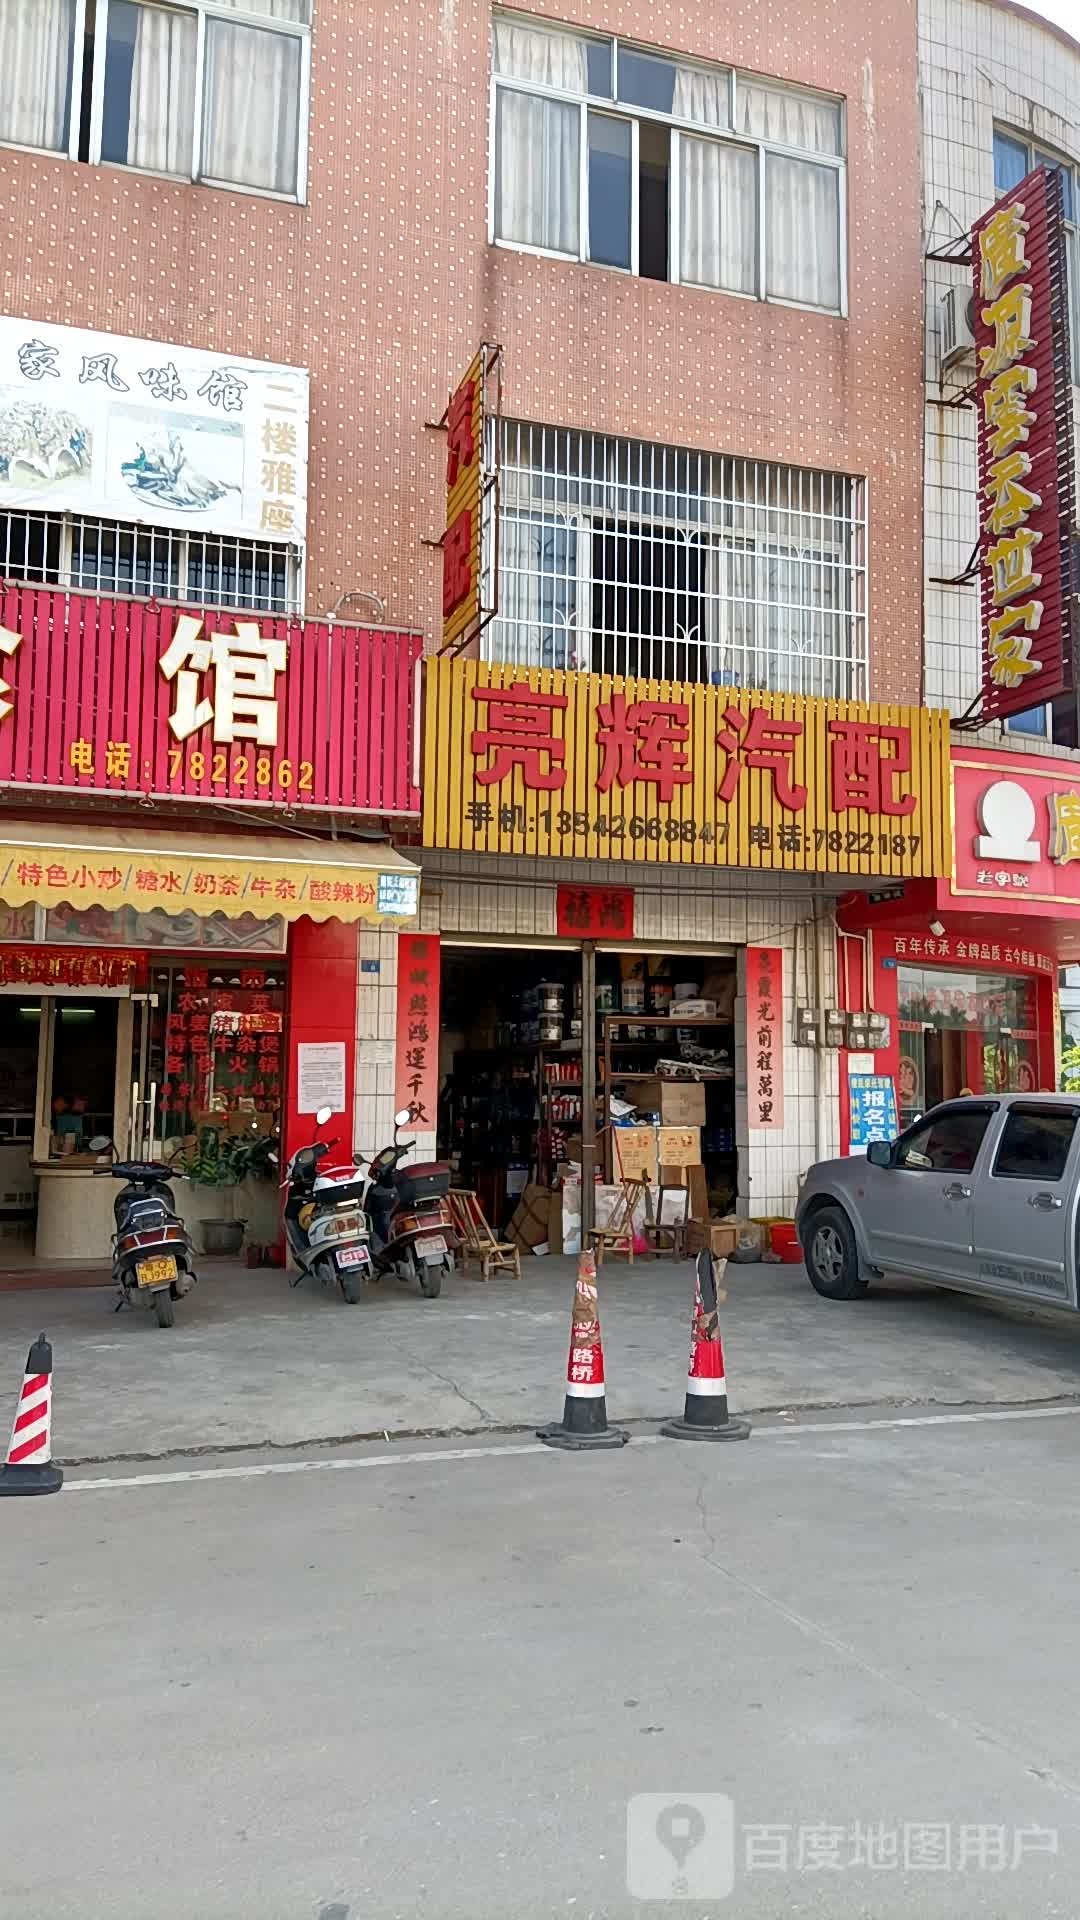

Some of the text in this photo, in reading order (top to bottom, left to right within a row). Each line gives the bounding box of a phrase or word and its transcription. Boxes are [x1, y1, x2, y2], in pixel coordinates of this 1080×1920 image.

[17, 339, 248, 412] 家风味馆
[260, 383, 298, 534] 二楼雅座
[159, 614, 287, 747] 馆
[471, 682, 917, 817] 亮辉汽配
[894, 937, 950, 956] 百年传承
[572, 1348, 594, 1381] 路桥
